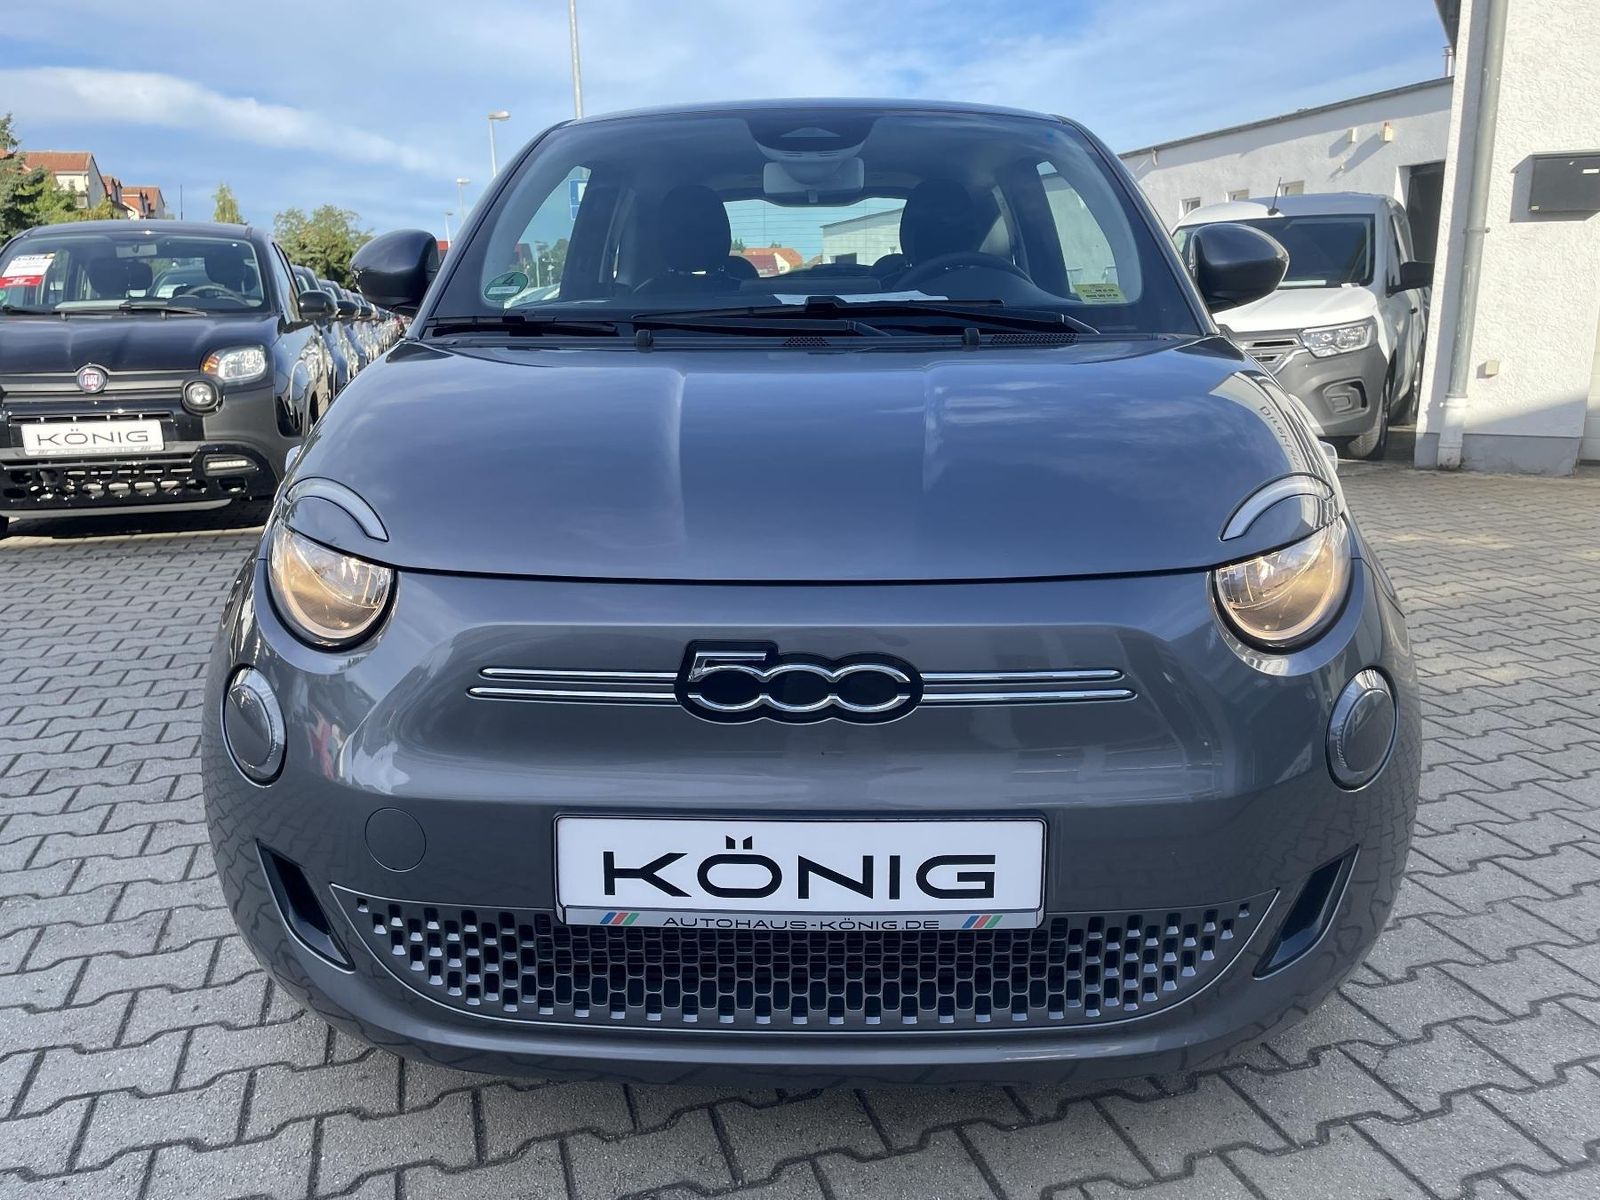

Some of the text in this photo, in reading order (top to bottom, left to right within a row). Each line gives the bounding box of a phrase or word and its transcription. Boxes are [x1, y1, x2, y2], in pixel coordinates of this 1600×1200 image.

[36, 427, 149, 446] KÖNIG
[687, 651, 911, 713] 500
[601, 835, 997, 900] KÖNIG
[662, 916, 940, 931] AUTOHAUS-KÖNIG.DE
